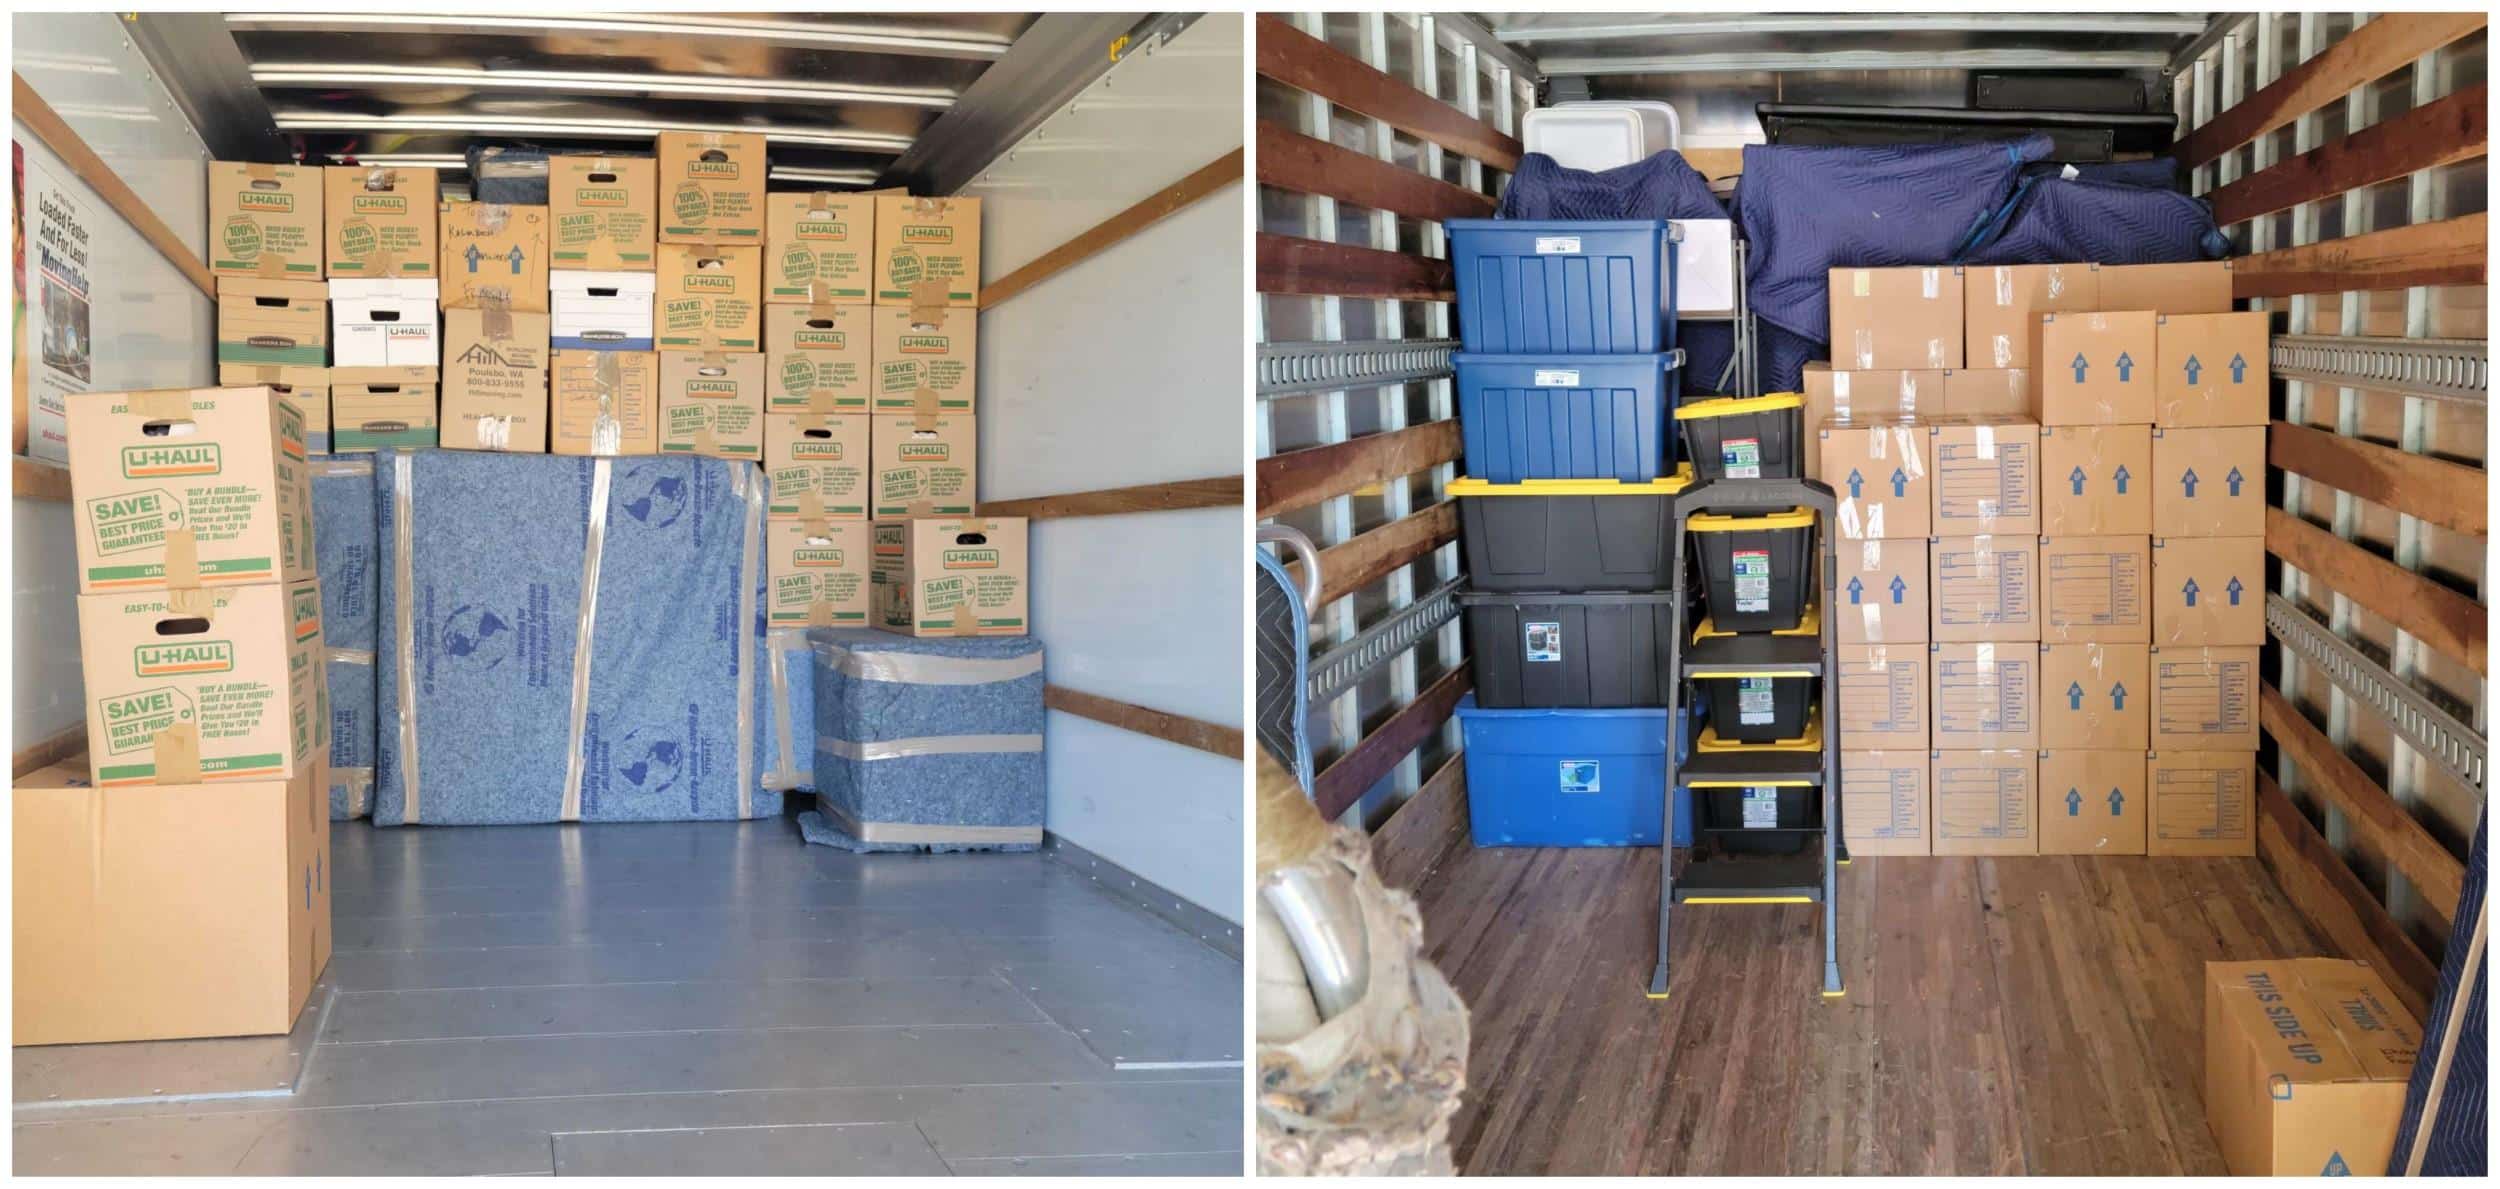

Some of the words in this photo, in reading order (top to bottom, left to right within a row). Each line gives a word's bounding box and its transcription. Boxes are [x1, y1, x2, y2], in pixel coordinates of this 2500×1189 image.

[691, 163, 737, 173] U-HAUL
[242, 194, 291, 206] U-HAUL
[580, 191, 625, 201] U-HAUL
[356, 199, 404, 208] U-HAUL
[40, 191, 67, 230] Loaded
[67, 215, 89, 246] Faster
[228, 224, 257, 237] 100%
[344, 226, 371, 239] 100%
[800, 224, 844, 234] U-HAUL
[905, 228, 950, 238] U-HAUL
[40, 219, 56, 245] And
[56, 230, 69, 255] For
[69, 240, 88, 269] Less!
[687, 277, 732, 287] U-HAUL
[667, 300, 701, 313] SAVE!
[390, 327, 428, 336] U-HAUL
[798, 334, 842, 343] U-HAUL
[902, 338, 946, 348] U-HAUL
[467, 349, 497, 366] Hill
[883, 362, 917, 374] SAVE!
[690, 383, 736, 392] U-HAUL
[670, 406, 705, 418] SAVE!
[795, 445, 840, 454] U-HAUL
[902, 446, 946, 455] U-HAUL
[129, 448, 215, 466] U-HAUL
[776, 469, 809, 481] SAVE!
[883, 470, 917, 482] SAVE!
[95, 495, 161, 520] SAVE!
[99, 524, 131, 539] BEST
[131, 518, 164, 533] PRICE
[797, 551, 840, 560] U-HAUL
[947, 551, 995, 562] U-HAUL
[778, 576, 811, 588] SAVE!
[926, 578, 963, 593] SAVE!
[142, 646, 227, 665] U-HAUL
[107, 692, 173, 719] SAVE!
[111, 722, 140, 738] BEST
[143, 716, 175, 733] PRICE
[113, 731, 155, 749] GUARAN
[2244, 971, 2283, 1002] THIS
[2265, 1006, 2308, 1040] SIDE
[2288, 1043, 2323, 1065] UP
[2329, 1162, 2344, 1176] UP
